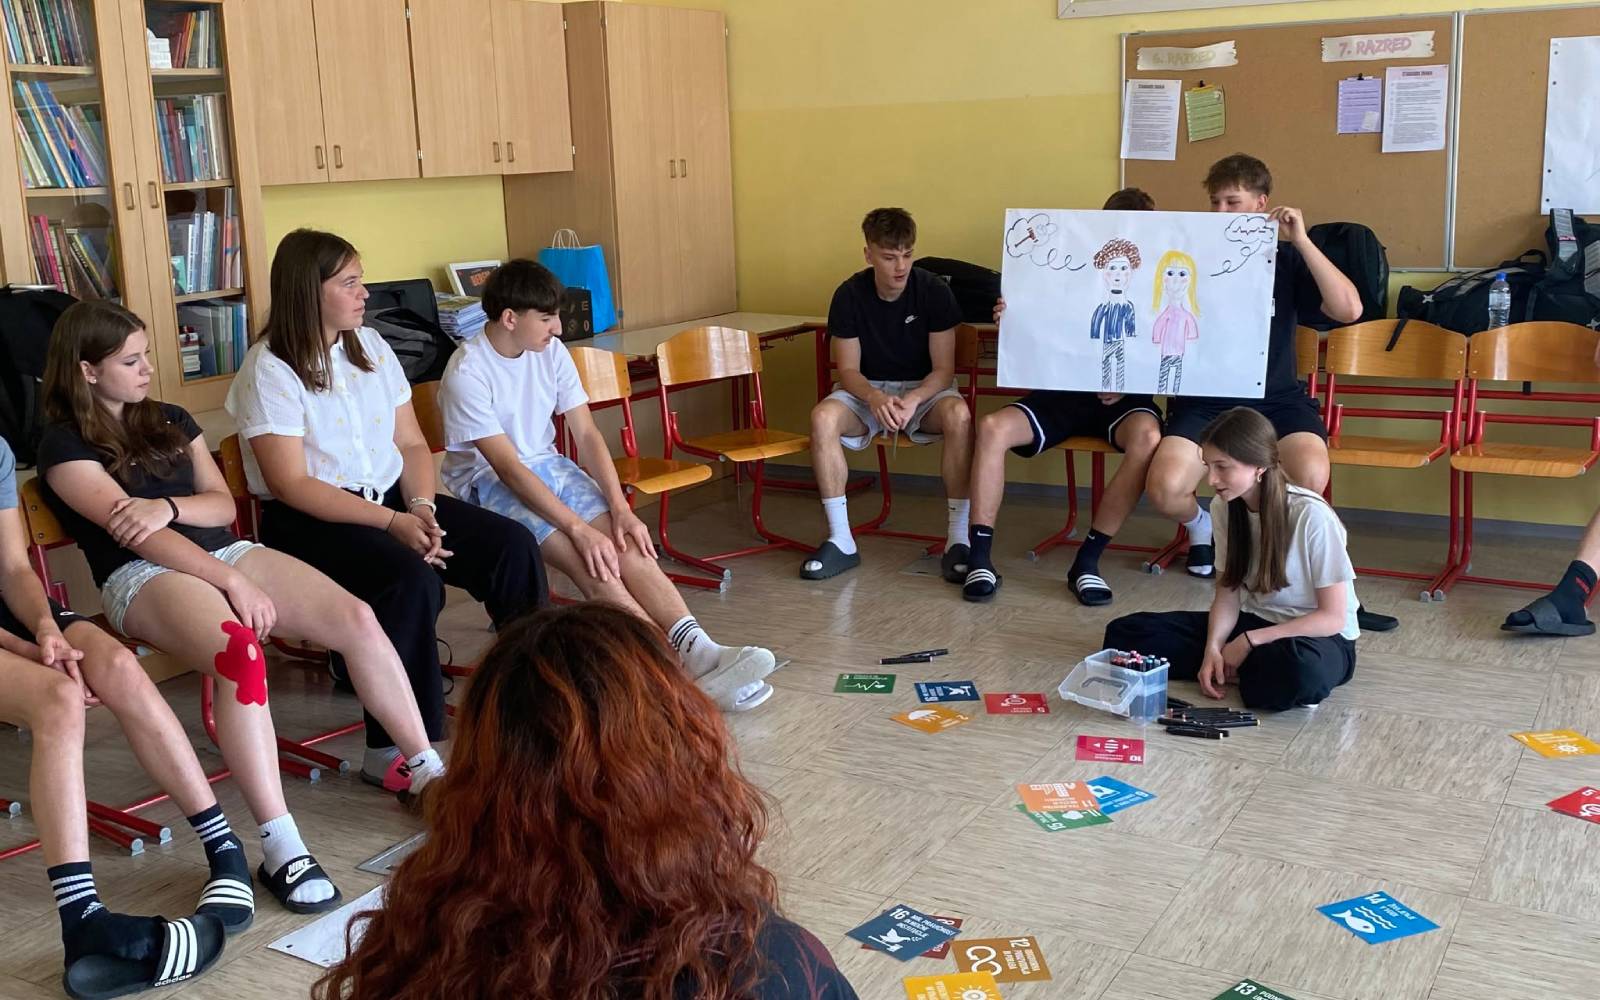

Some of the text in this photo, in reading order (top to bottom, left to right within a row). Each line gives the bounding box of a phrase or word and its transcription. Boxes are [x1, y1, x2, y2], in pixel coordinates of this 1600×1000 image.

[1338, 37, 1412, 56] 7. RAZRED
[1167, 49, 1216, 66] RAZRED
[1129, 754, 1142, 762] 10
[288, 858, 311, 876] NIKE
[1363, 893, 1387, 904] 14
[889, 907, 910, 920] 16
[1008, 937, 1031, 948] 12
[154, 973, 192, 987] adidas
[1234, 982, 1257, 995] 13
